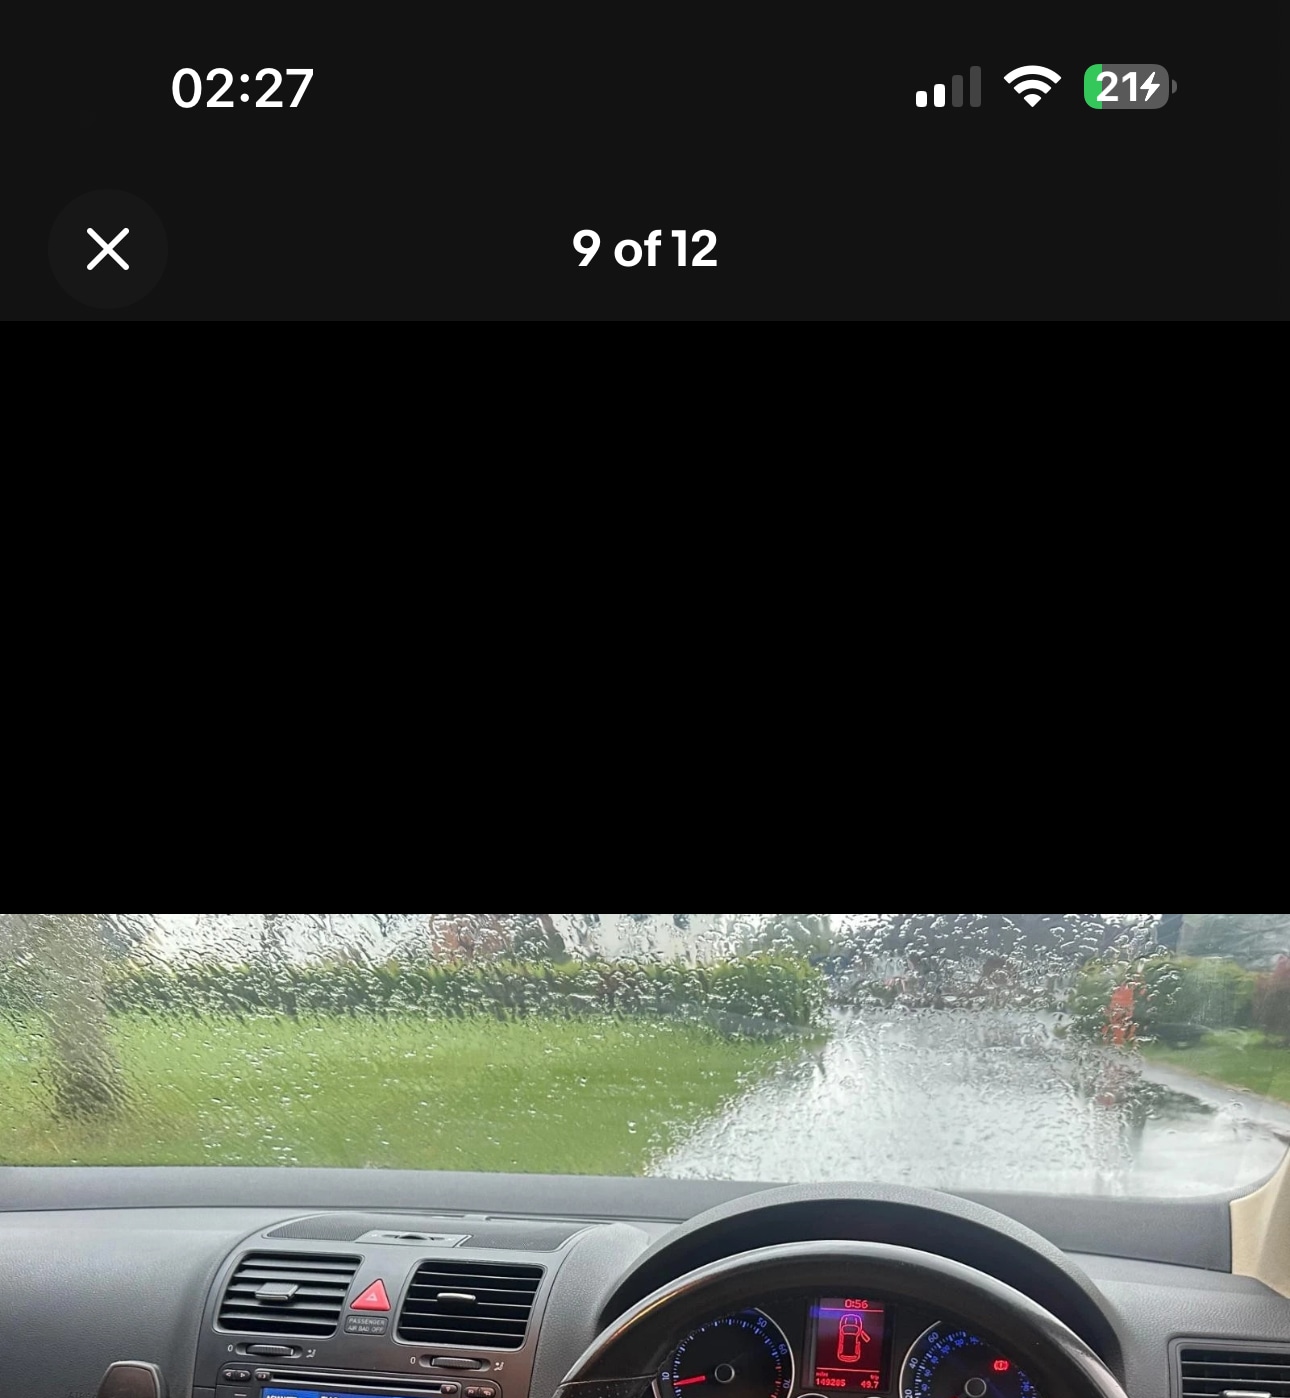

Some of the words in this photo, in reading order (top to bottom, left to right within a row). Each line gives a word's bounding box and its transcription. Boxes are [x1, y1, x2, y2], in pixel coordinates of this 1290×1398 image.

[845, 1299, 868, 1308] 0:56
[348, 1318, 385, 1326] PASSENGER
[928, 1332, 939, 1342] 60
[778, 1344, 787, 1355] 60
[909, 1358, 918, 1369] 40
[662, 1372, 670, 1380] 10
[905, 1389, 913, 1398] 20
